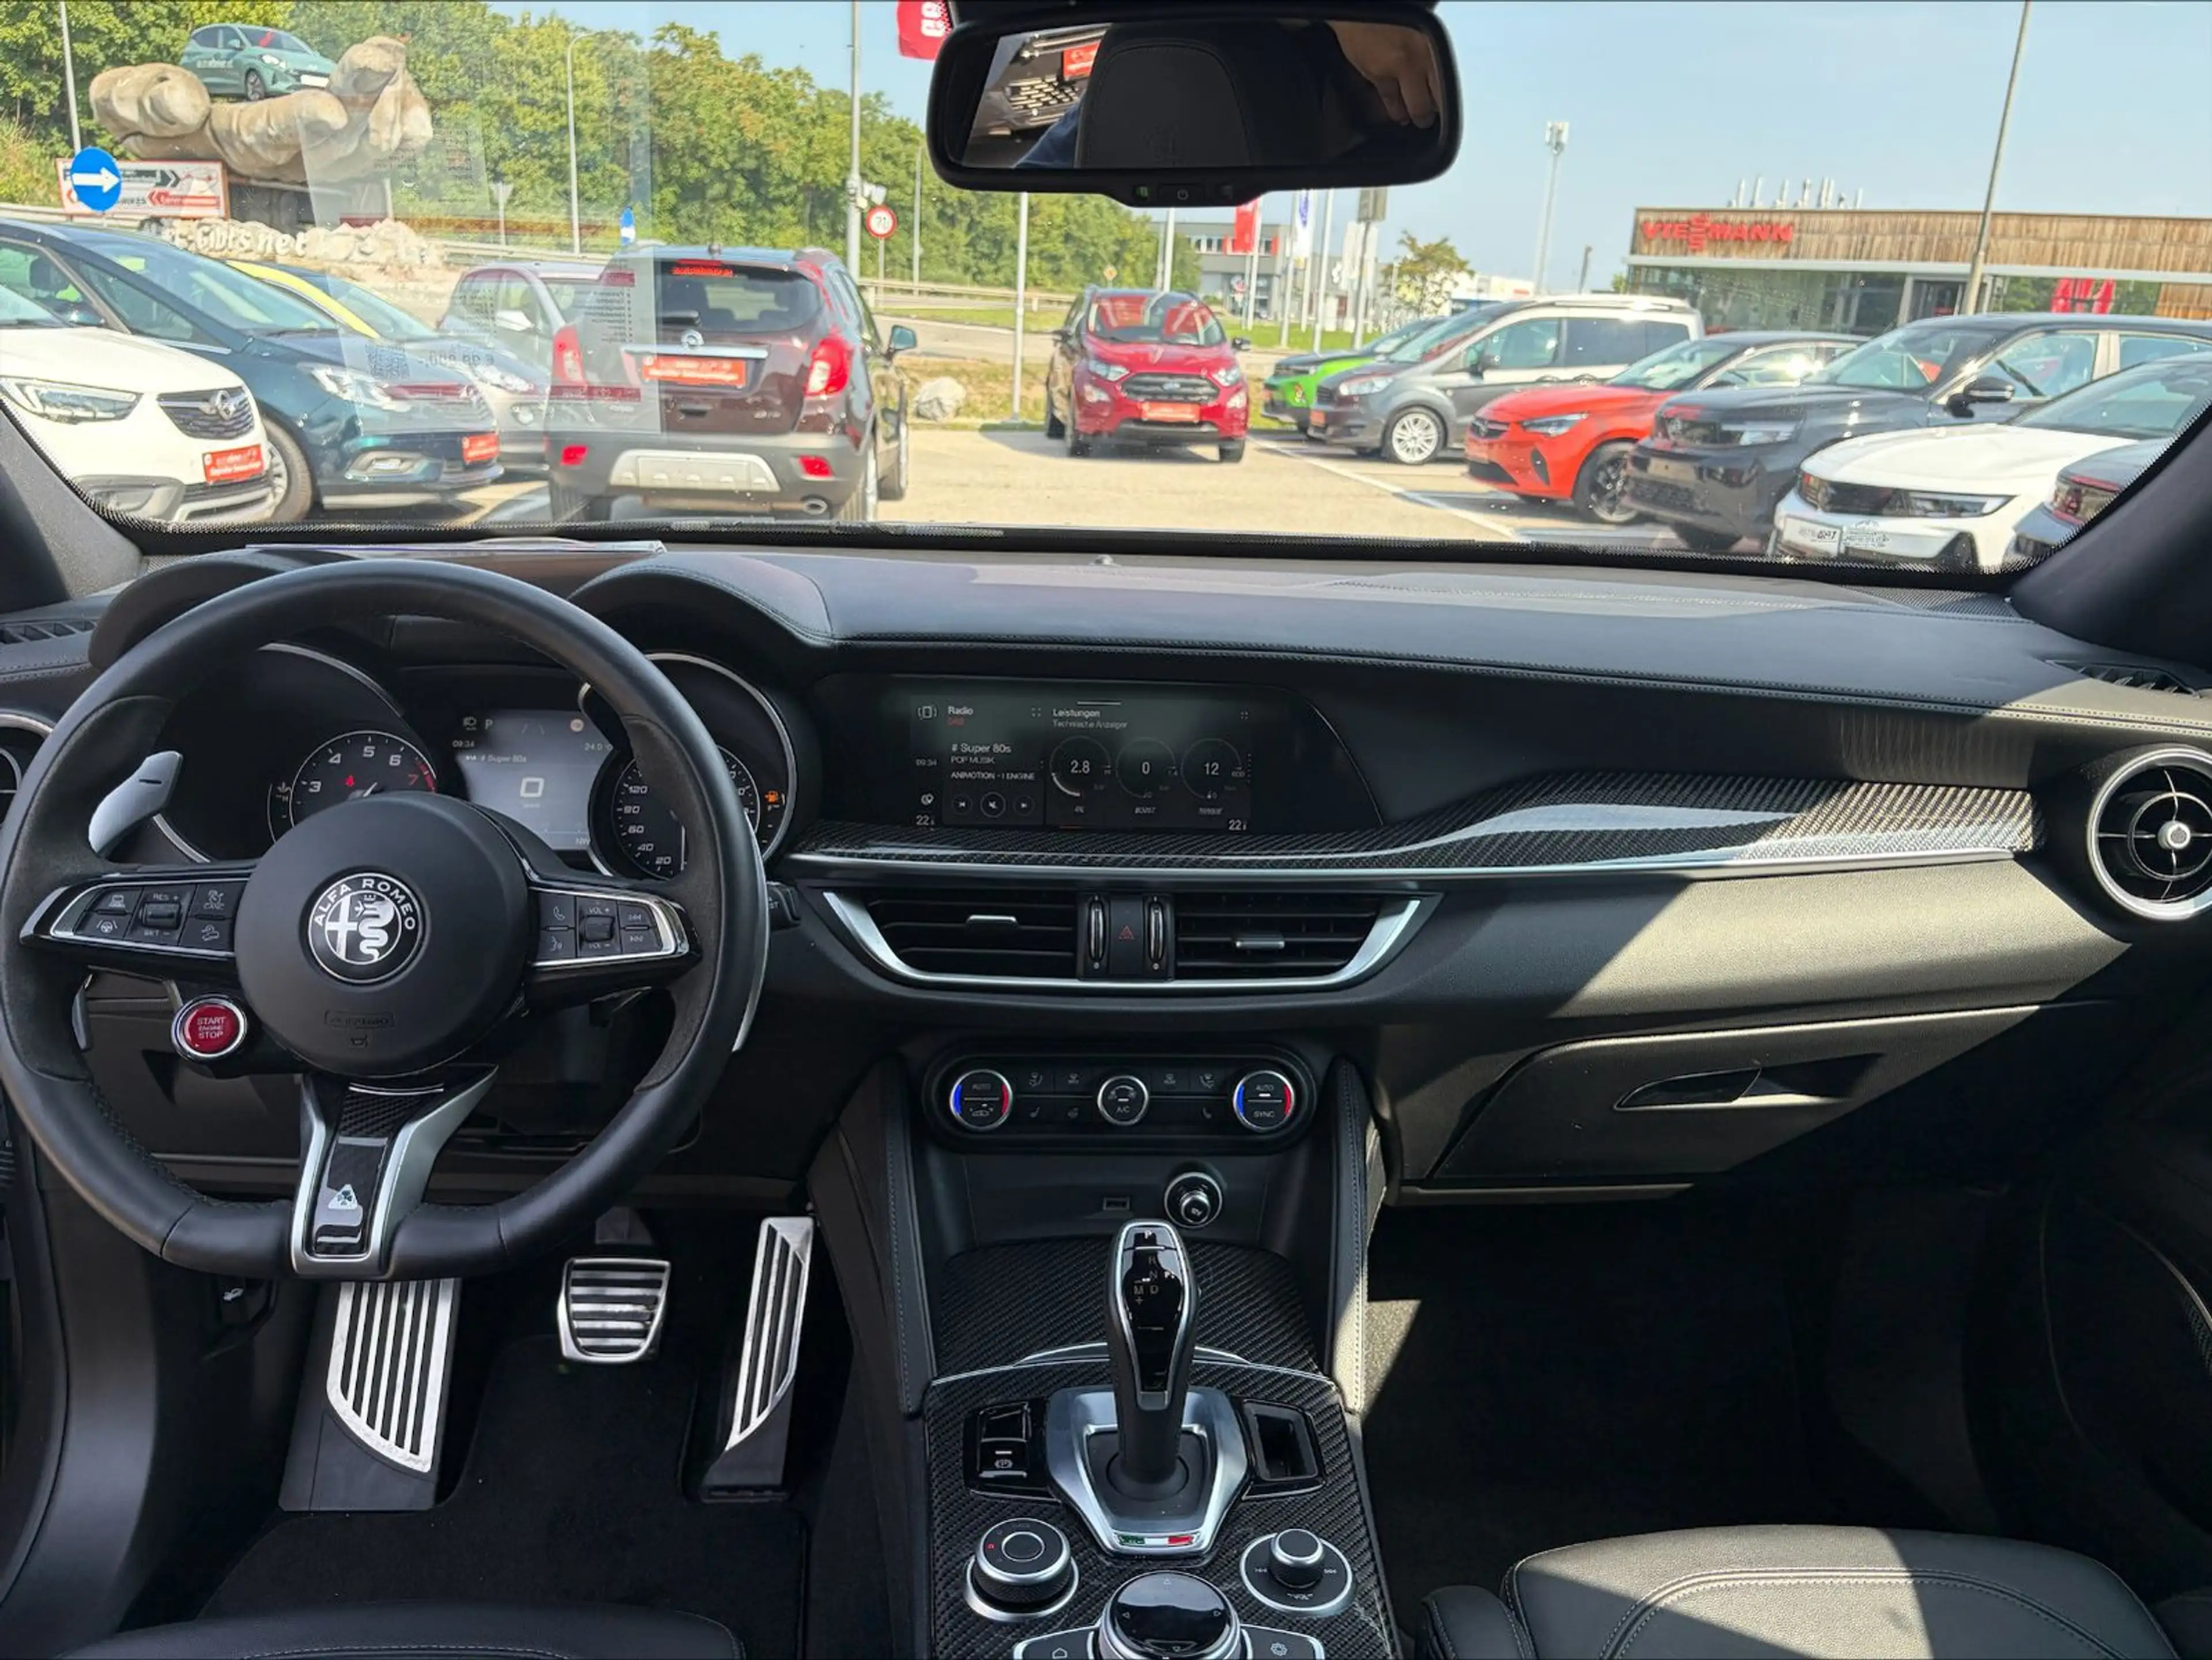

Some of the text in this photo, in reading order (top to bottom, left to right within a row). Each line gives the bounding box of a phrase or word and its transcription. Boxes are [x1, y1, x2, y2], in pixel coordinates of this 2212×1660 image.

[948, 706, 973, 716] Radio
[363, 746, 375, 757] 5
[960, 743, 989, 754] Super
[328, 753, 341, 764] 4
[389, 754, 402, 766] 6
[1071, 760, 1090, 774] 2.8
[1142, 761, 1151, 775] 0
[1204, 762, 1219, 775] 12
[408, 774, 419, 786] 7
[308, 781, 322, 793] 3
[520, 777, 545, 798] 0
[628, 825, 644, 833] 60
[638, 843, 654, 852] 40
[655, 856, 672, 865] 20
[314, 878, 416, 930] ALFA ROMEO
[197, 1017, 225, 1025] START
[199, 1031, 224, 1039] STOP
[1144, 1230, 1152, 1239] P
[1150, 1285, 1159, 1295] D
